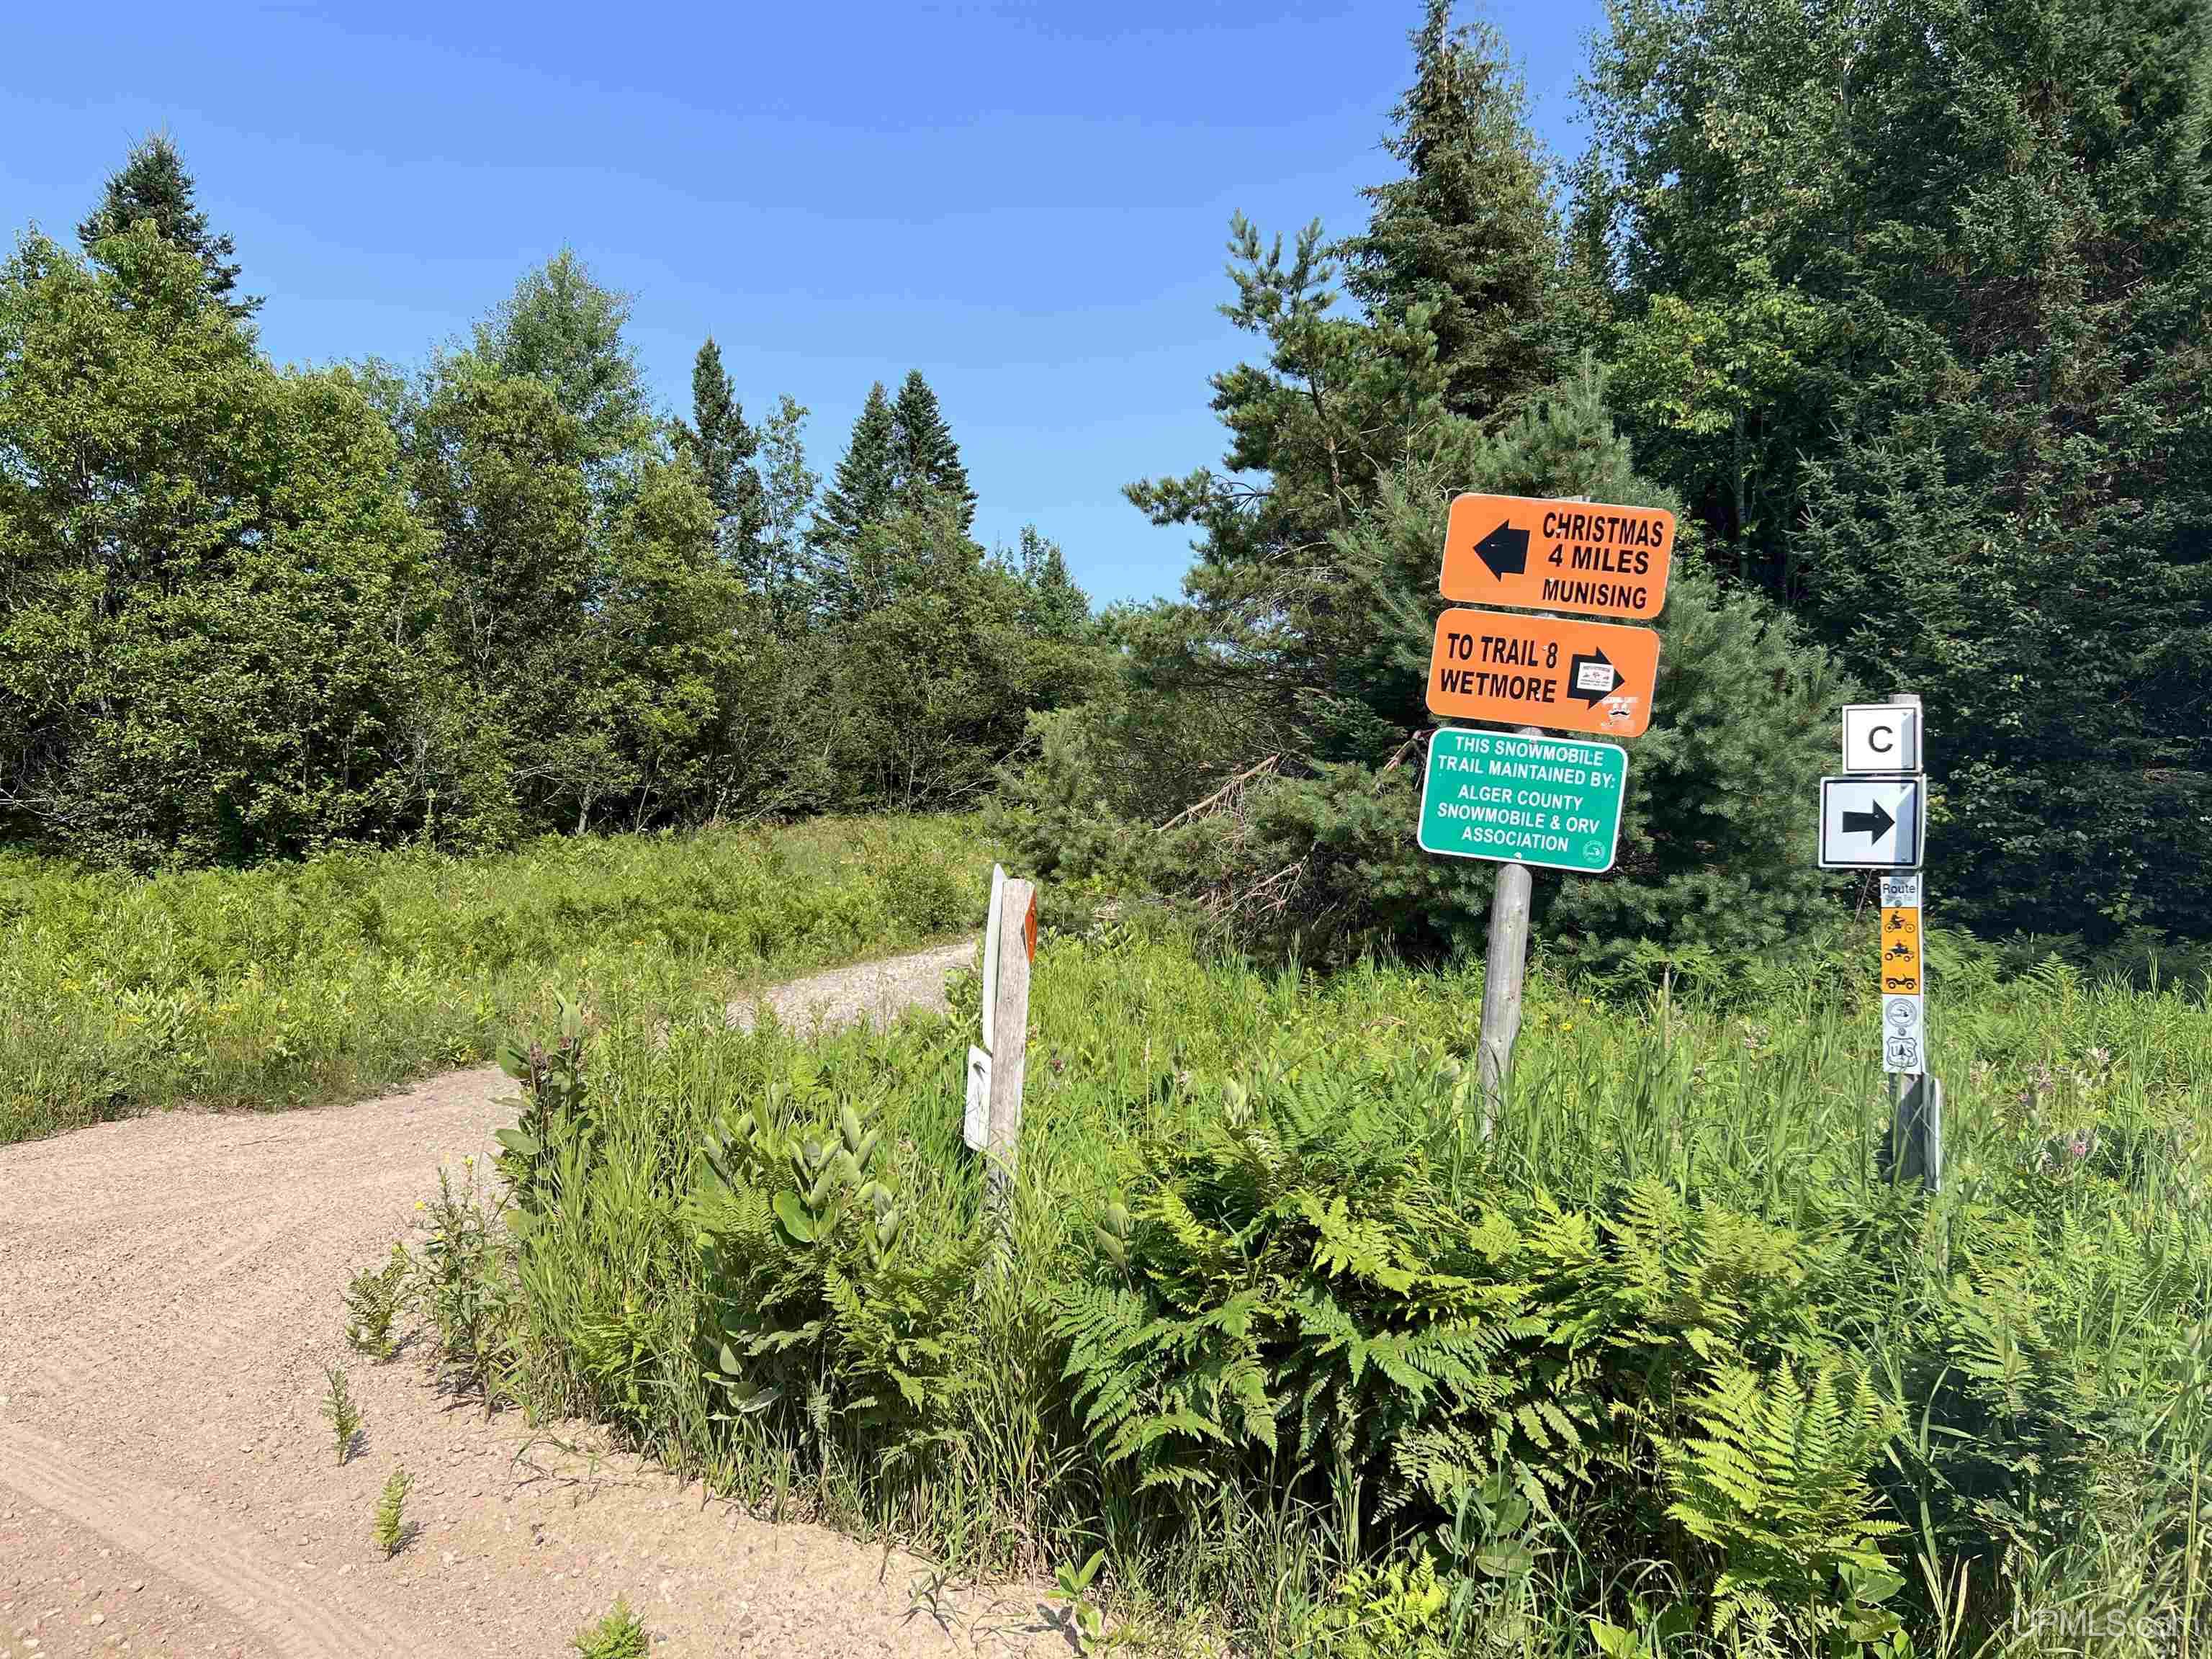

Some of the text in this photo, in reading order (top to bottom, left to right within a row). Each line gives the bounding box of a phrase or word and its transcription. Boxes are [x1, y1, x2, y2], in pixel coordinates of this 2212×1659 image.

[1542, 512, 1664, 547] CHRISTMAS
[1548, 544, 1650, 575] 4 MILES
[1542, 579, 1647, 609] MUNISING
[1447, 633, 1559, 669] TO TRAIL 8
[1440, 669, 1557, 703] WETMORE
[1455, 736, 1604, 766] THIS SNOWMOBILE
[1869, 726, 1894, 753] C
[1438, 755, 1616, 789] TRAIL MAINTAINED BY:
[1457, 784, 1583, 811] ALGER COUNTY
[1437, 802, 1601, 835] SNOWMOBILE & ORV
[1461, 827, 1569, 852] ASSOCIATION
[1883, 884, 1915, 894] Route
